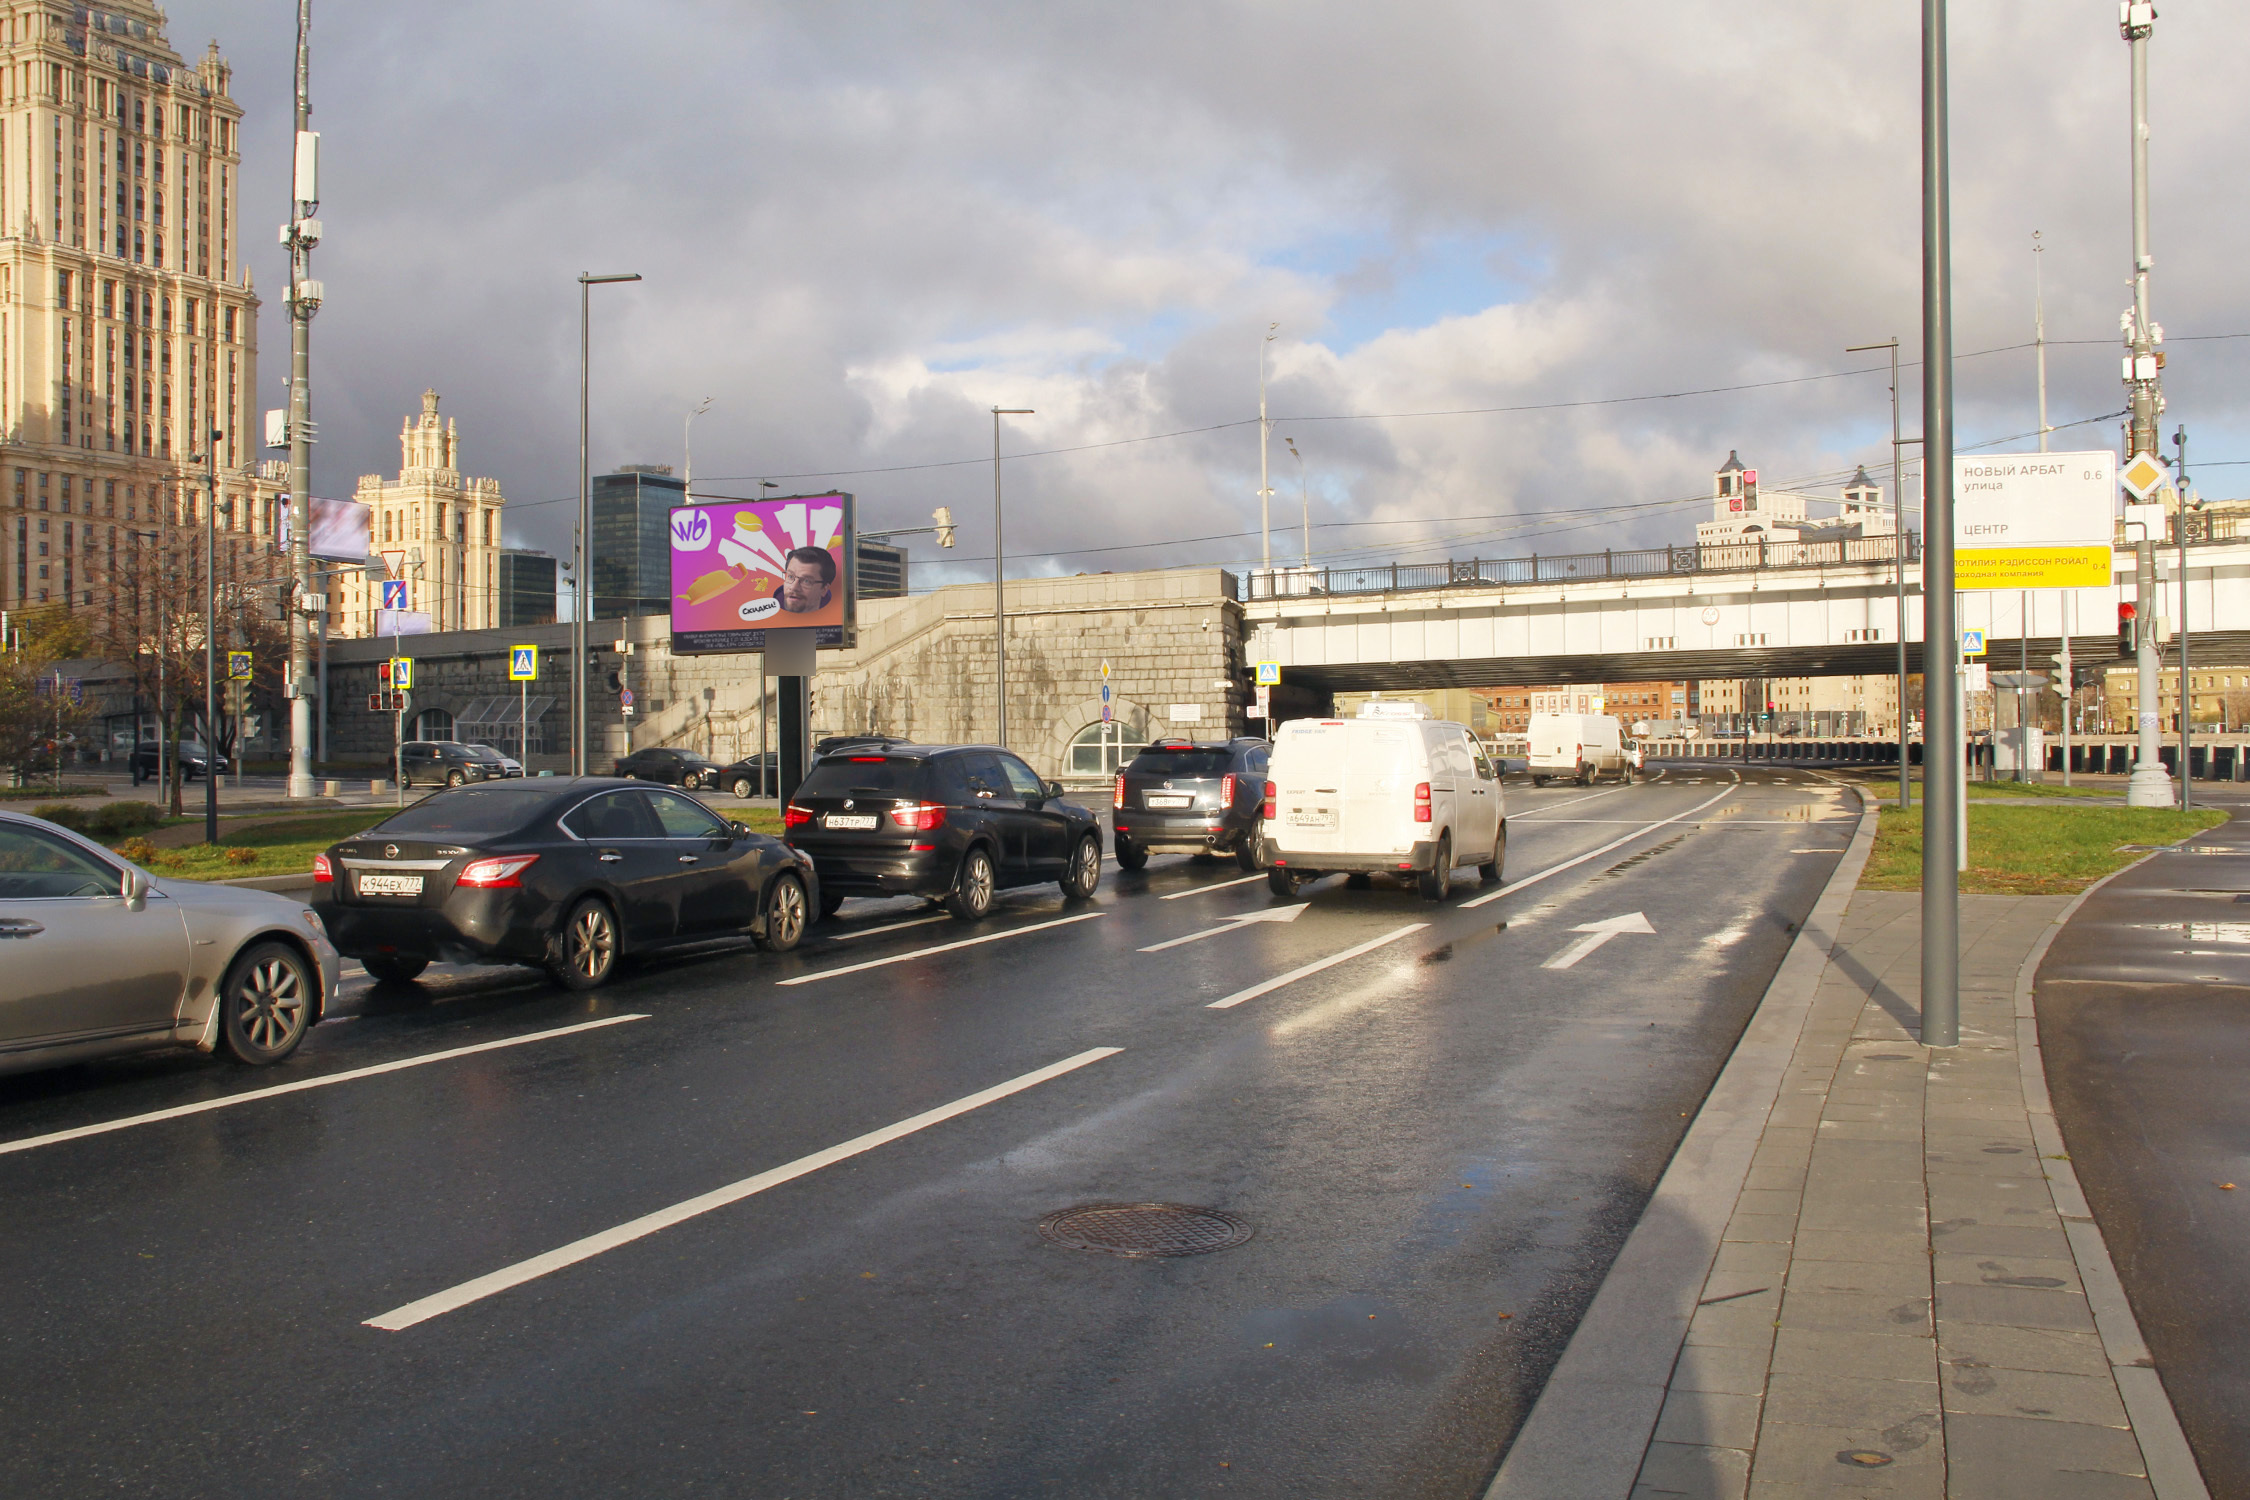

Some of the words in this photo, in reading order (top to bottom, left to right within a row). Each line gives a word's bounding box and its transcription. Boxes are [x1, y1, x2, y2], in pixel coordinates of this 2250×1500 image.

[1964, 464, 2016, 477] НОВЫЙ
[2020, 464, 2065, 476] АРБАТ
[2083, 470, 2103, 480] 0.6
[1964, 482, 2003, 493] улица
[1964, 524, 2009, 536] ЦЕНТР
[2000, 558, 2052, 567] РЭДИССОН
[2055, 557, 2088, 565] РОЙАЛ
[742, 601, 777, 615] Скидки!
[362, 877, 402, 891] К944ЕХ
[404, 877, 420, 888] 777
